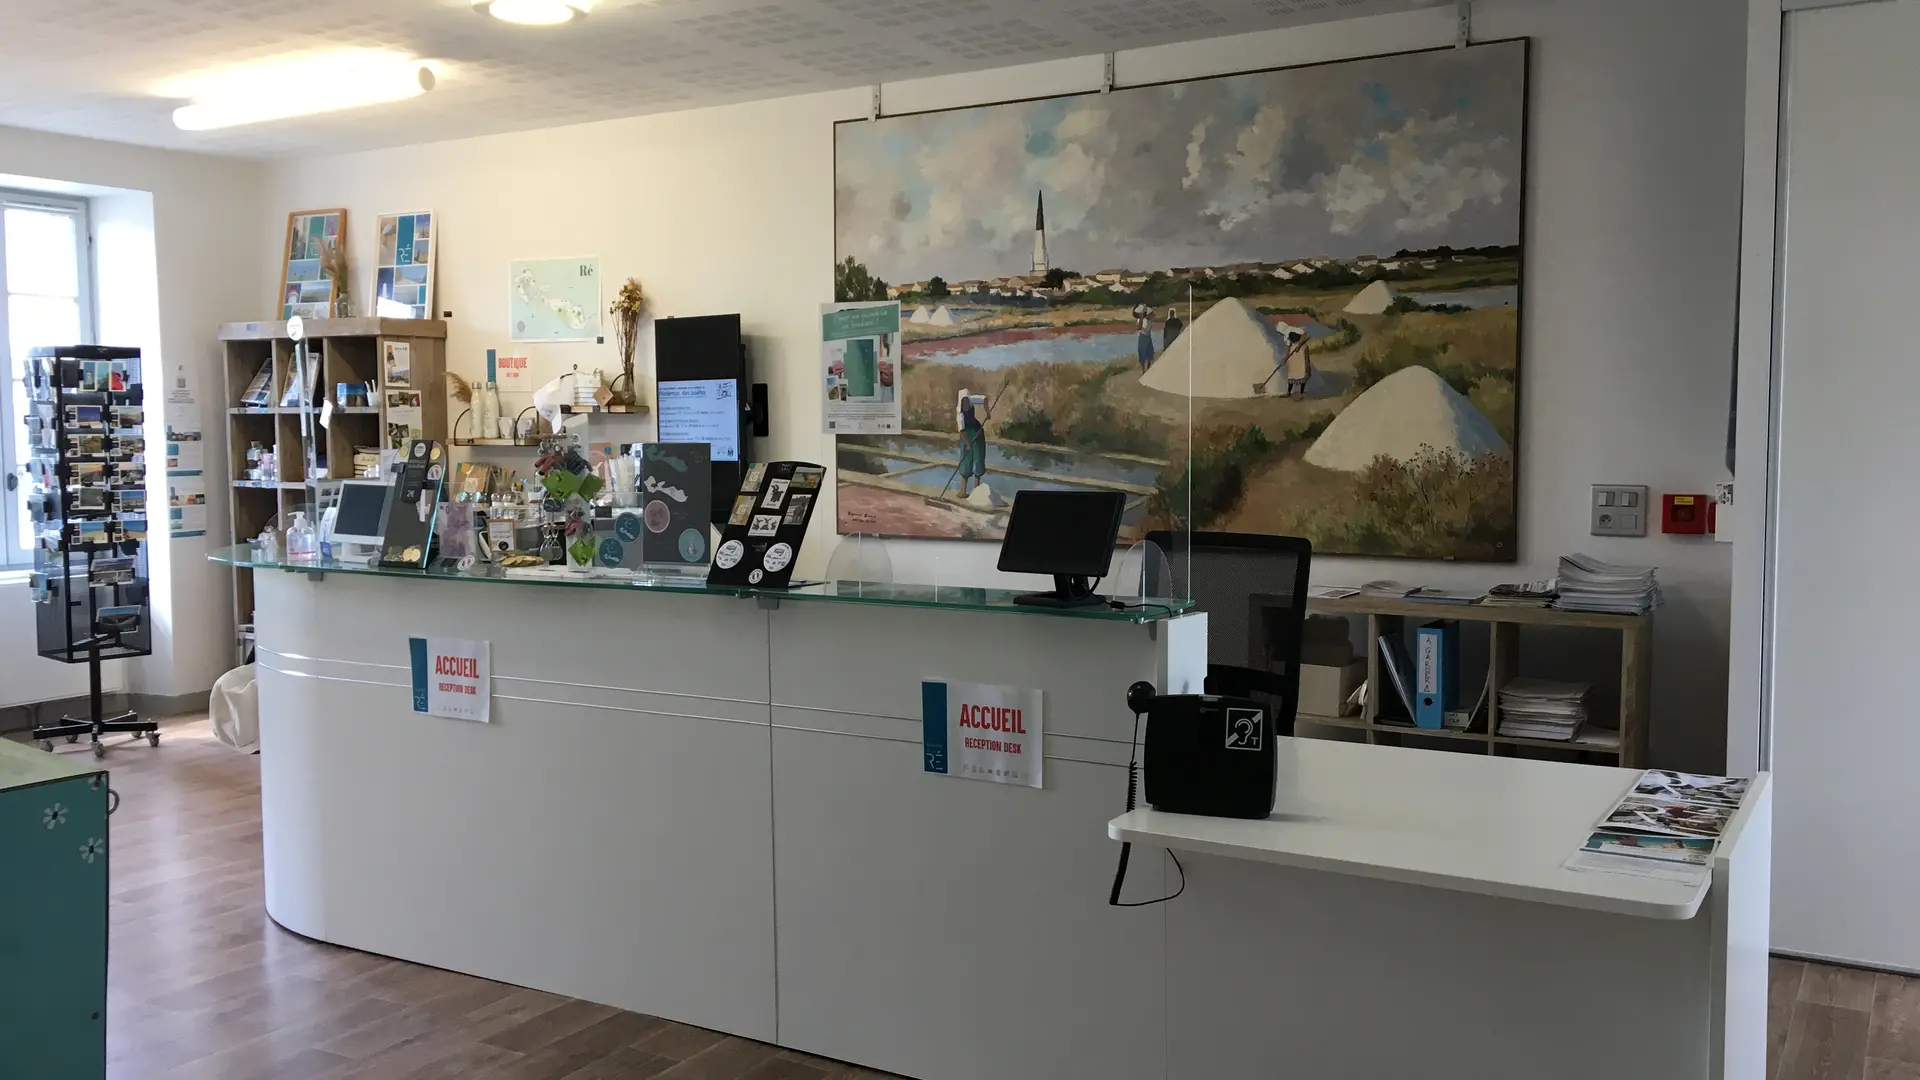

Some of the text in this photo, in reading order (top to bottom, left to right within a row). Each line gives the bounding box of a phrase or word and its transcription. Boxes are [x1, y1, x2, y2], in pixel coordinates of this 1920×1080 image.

[579, 264, 594, 277] Ré
[498, 357, 528, 370] BOUTIQUE
[435, 655, 480, 679] ACCUEIL
[438, 682, 477, 695] RECEPTION DESK
[414, 692, 426, 710] RÉ
[959, 703, 1027, 734] ACCUEIL
[964, 737, 1022, 754] RECEPTION DESK
[1251, 736, 1259, 746] T
[926, 750, 944, 770] RÉ
